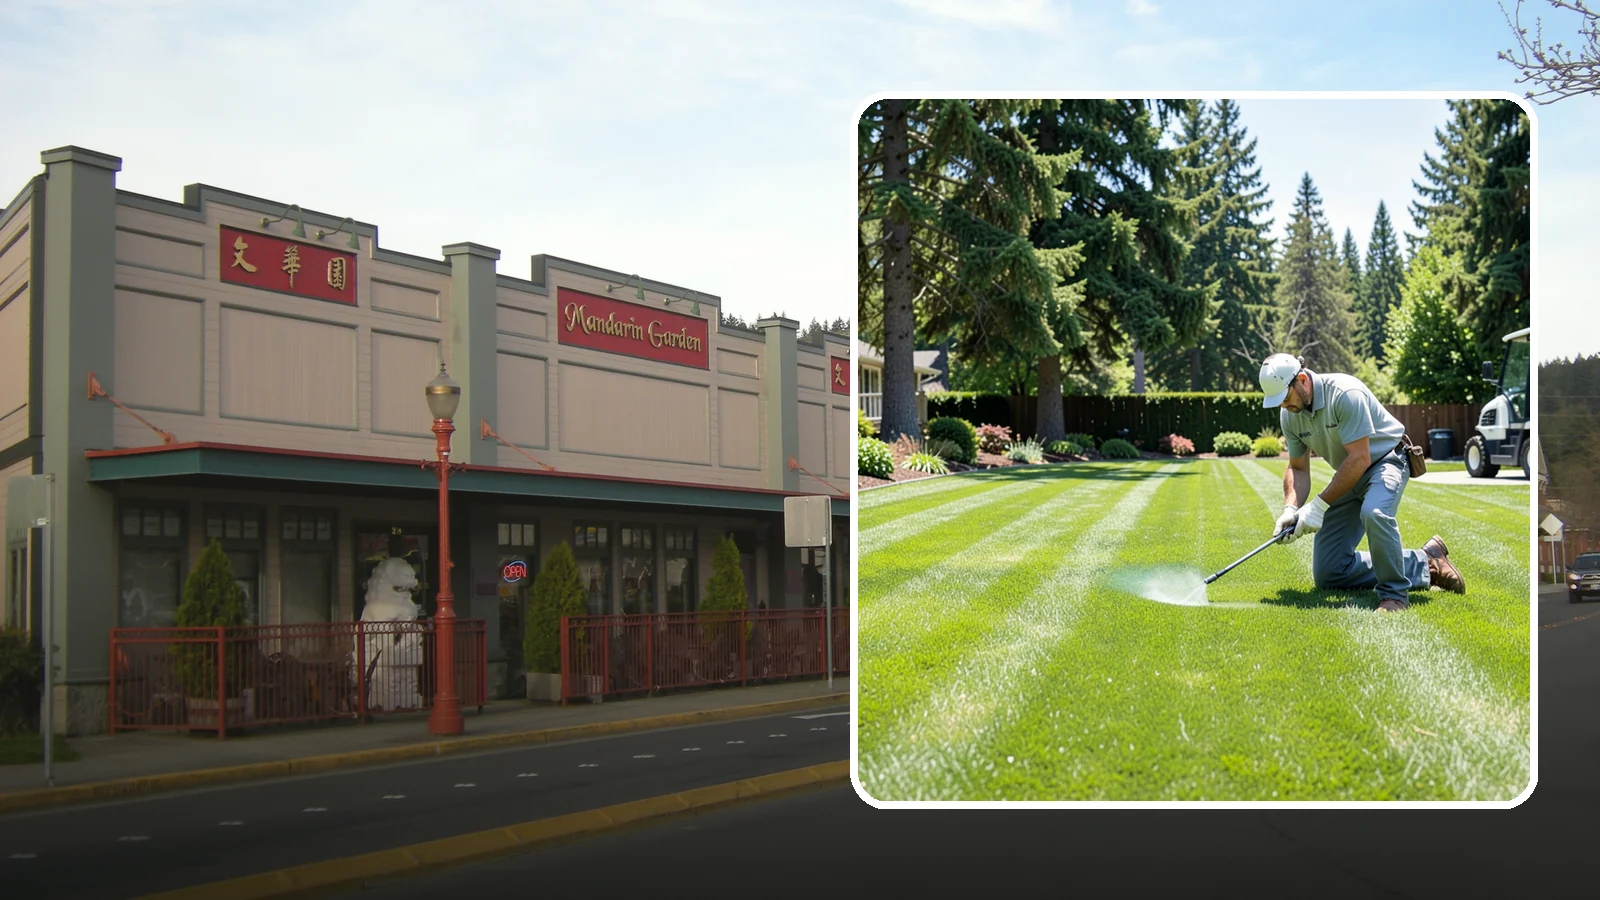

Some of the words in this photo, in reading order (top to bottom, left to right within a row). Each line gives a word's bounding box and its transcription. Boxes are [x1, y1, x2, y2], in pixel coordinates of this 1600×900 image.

[231, 235, 346, 291] 文華園
[564, 302, 644, 341] Mandarin
[648, 320, 702, 352] Garden
[503, 565, 527, 578] OPEN
